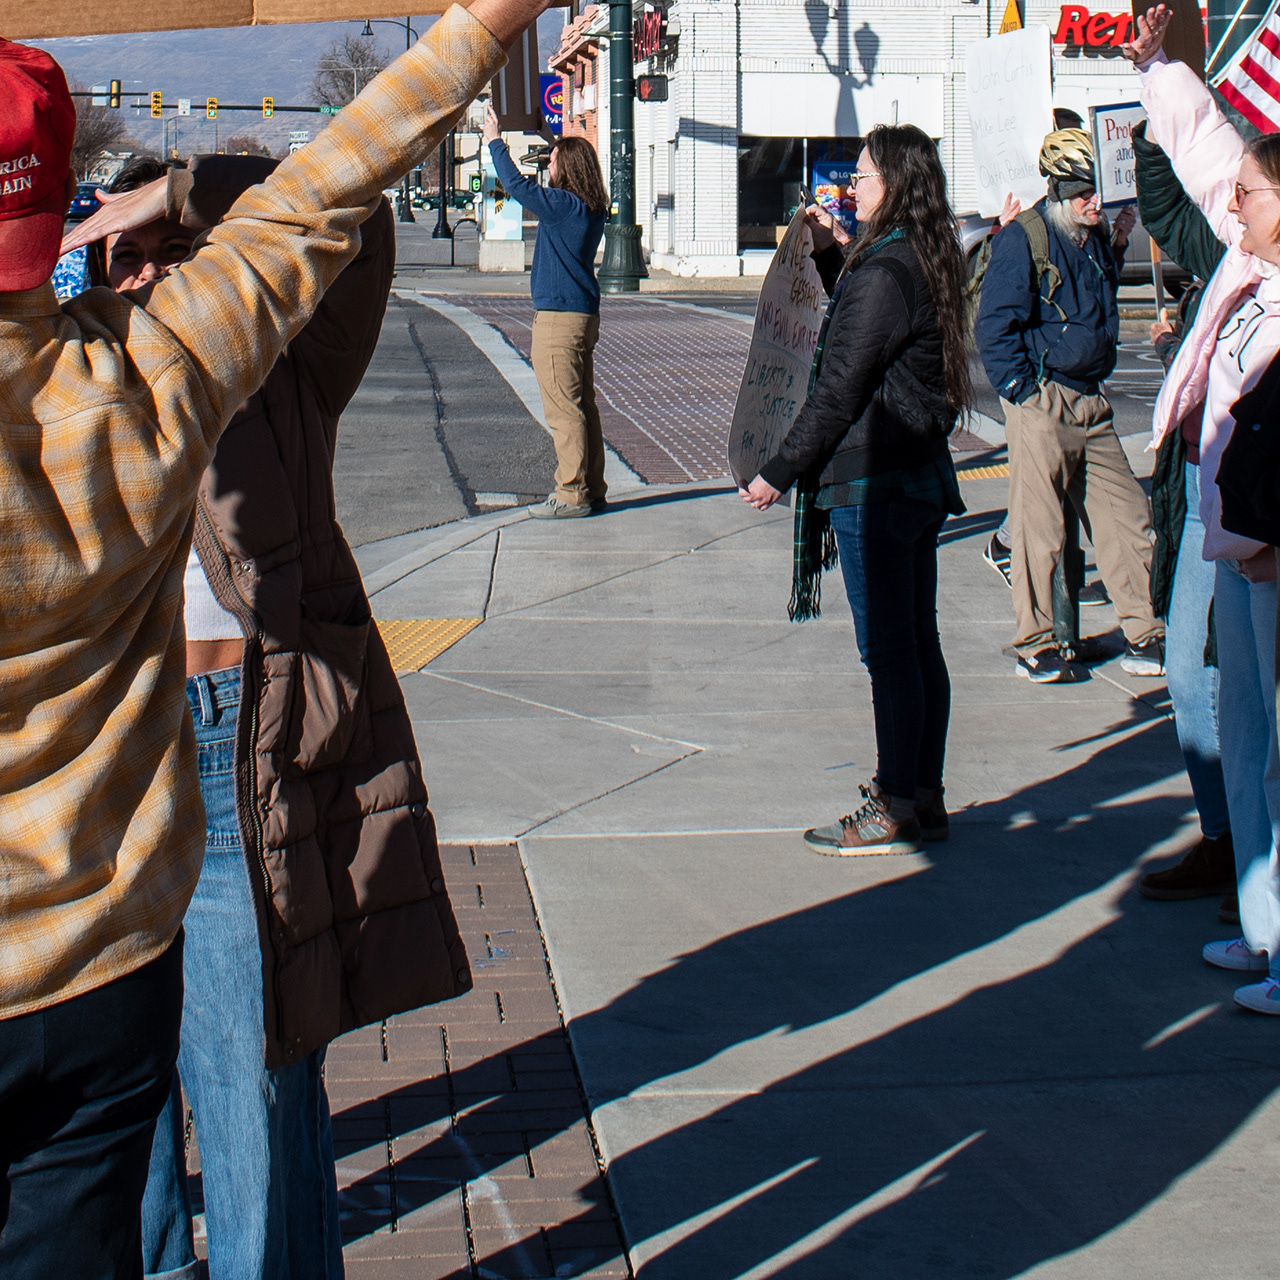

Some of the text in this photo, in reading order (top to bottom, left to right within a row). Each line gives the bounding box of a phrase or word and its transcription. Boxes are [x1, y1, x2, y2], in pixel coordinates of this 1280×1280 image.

[971, 46, 1034, 94] John Curtis
[972, 114, 1017, 140] Mike Lee
[979, 160, 1010, 189] Oath
[1114, 165, 1123, 186] it
[790, 240, 810, 271] ICE
[773, 308, 790, 347] EVIL
[748, 358, 787, 388] LIBERTY
[759, 394, 796, 420] JUSTICE
